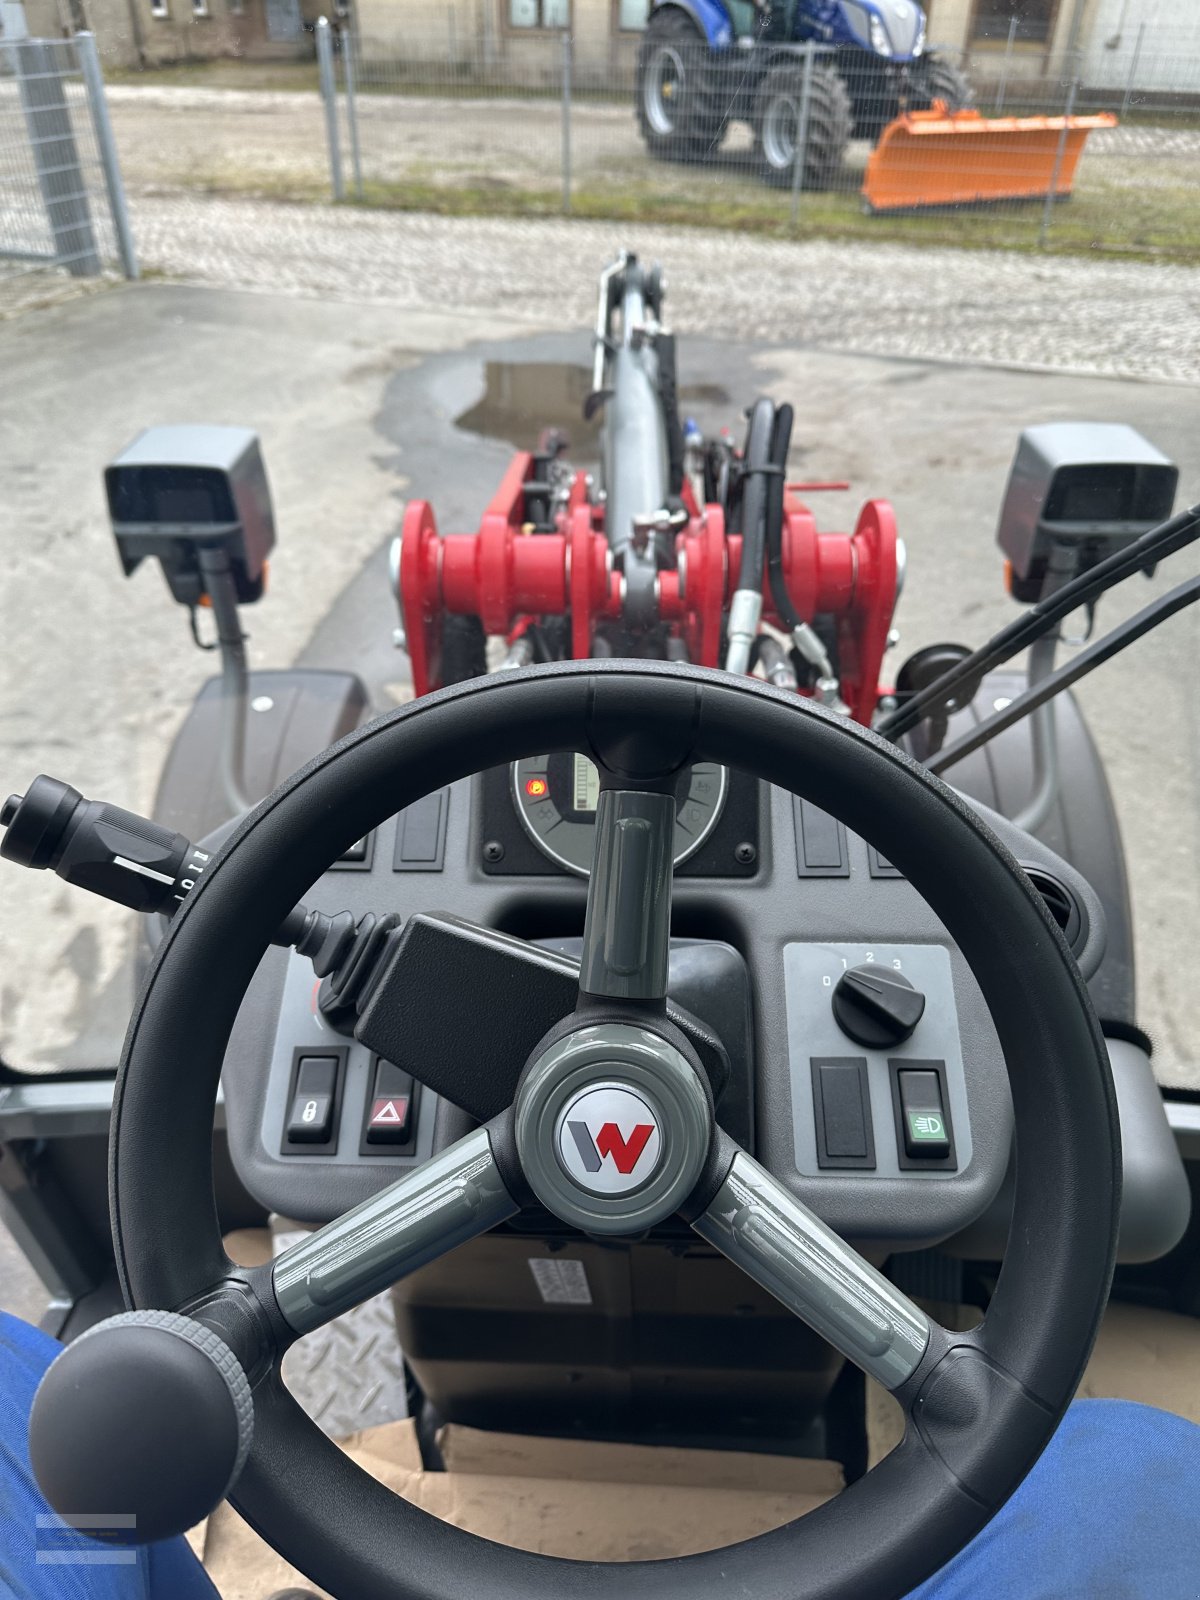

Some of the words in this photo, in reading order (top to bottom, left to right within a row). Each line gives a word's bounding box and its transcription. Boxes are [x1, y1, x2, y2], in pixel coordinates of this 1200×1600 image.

[841, 959, 847, 969] 1
[866, 952, 874, 962] 2
[893, 959, 901, 970] 3
